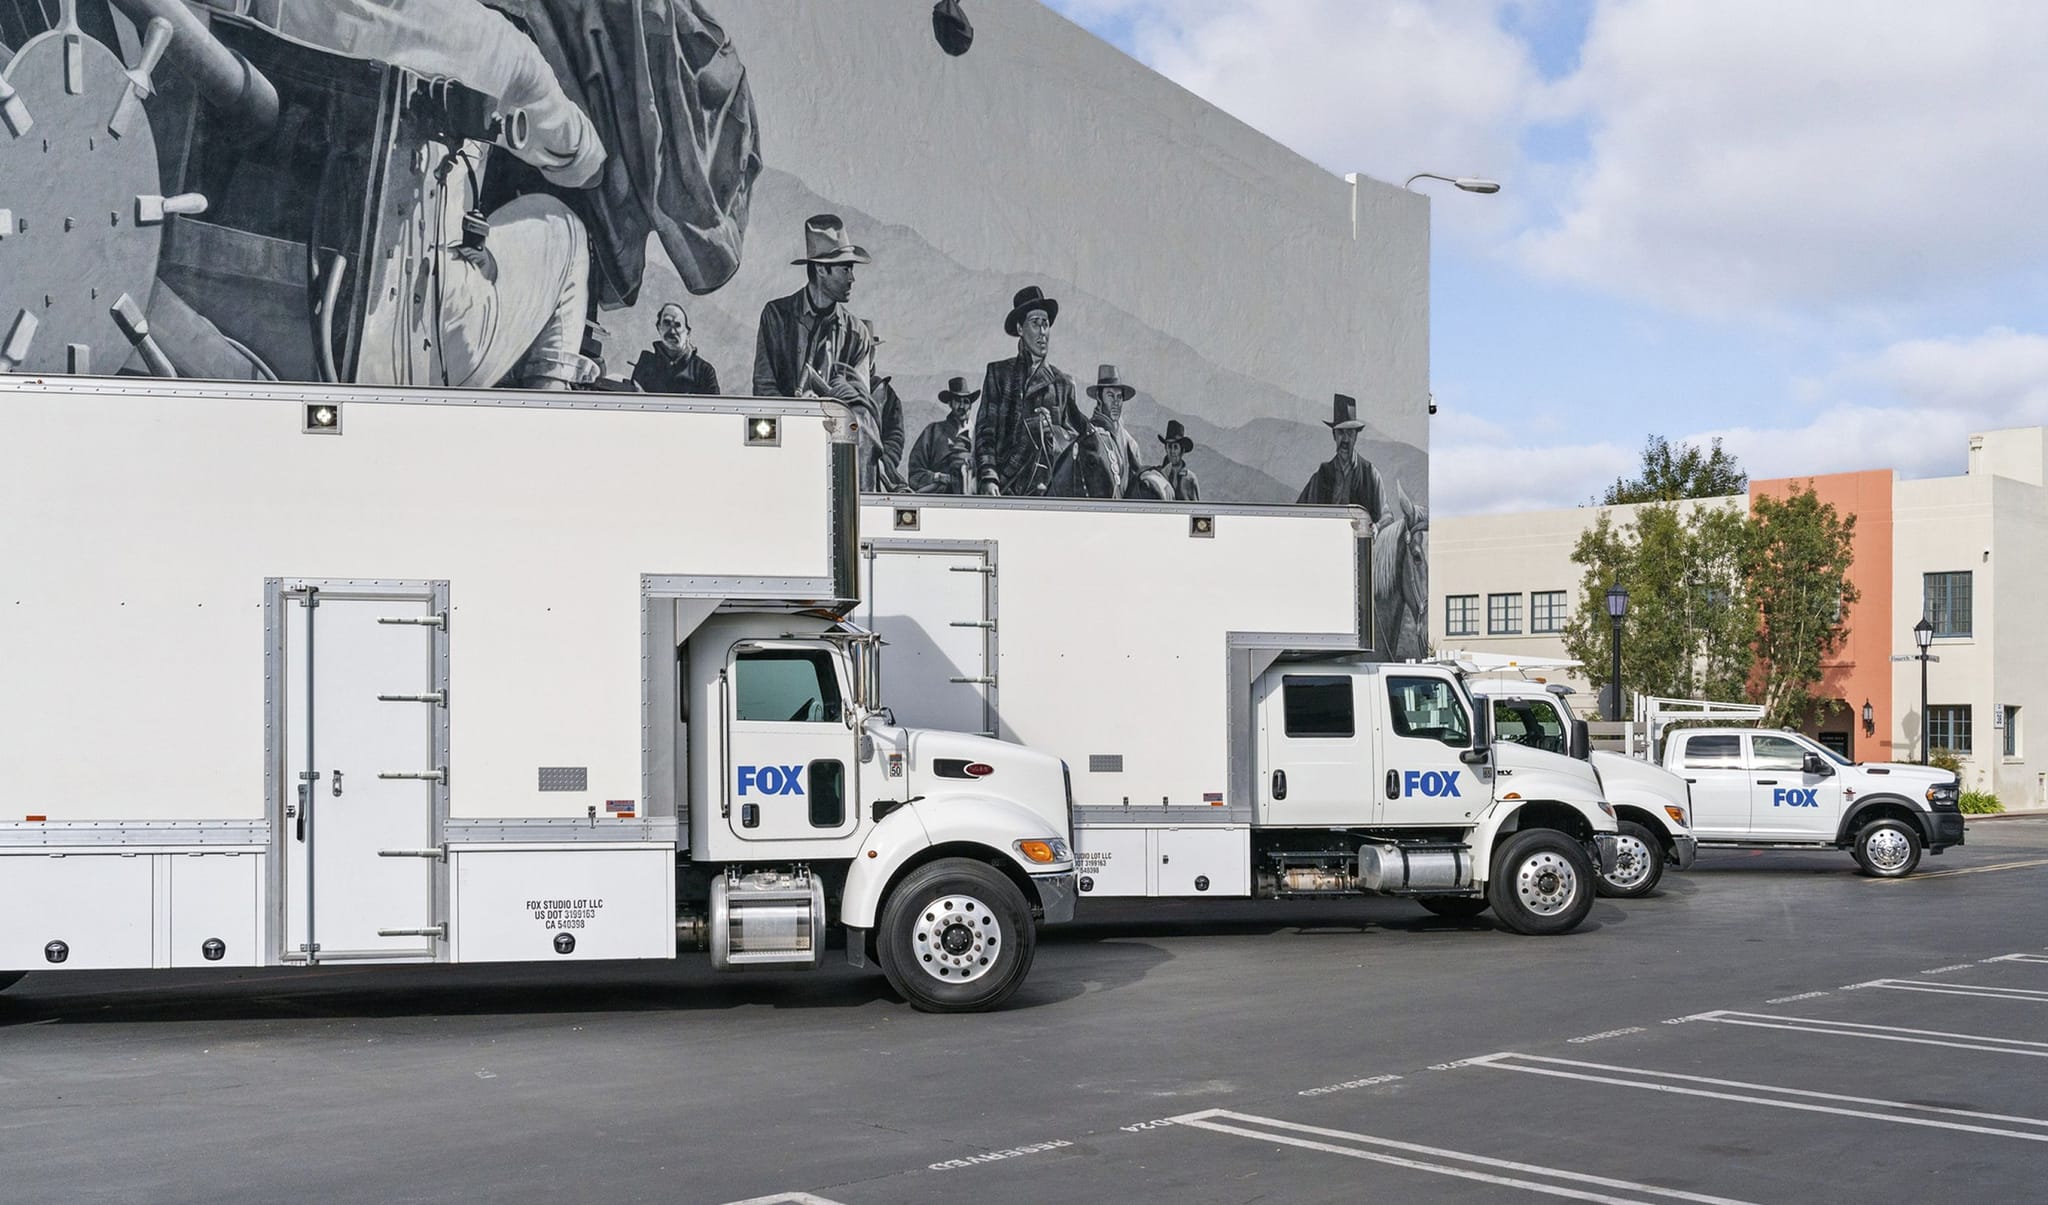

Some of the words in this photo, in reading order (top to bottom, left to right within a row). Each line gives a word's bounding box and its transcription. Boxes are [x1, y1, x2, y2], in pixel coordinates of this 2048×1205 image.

[738, 766, 804, 795] FOX
[1404, 771, 1461, 797] FOX
[1774, 788, 1818, 807] FOX
[1074, 852, 1090, 860] TUDIO
[1091, 852, 1100, 860] LOT
[1101, 852, 1112, 860] LLC
[526, 900, 541, 910] FOX
[543, 900, 571, 909] STUDIO
[573, 899, 587, 909] LOT
[589, 899, 603, 908] LLC
[535, 910, 545, 920] US
[547, 910, 562, 919] DOT
[564, 909, 595, 919] 3199163
[545, 920, 556, 929] CA
[557, 919, 585, 929] 540398
[928, 1138, 1074, 1171] RESERVED
